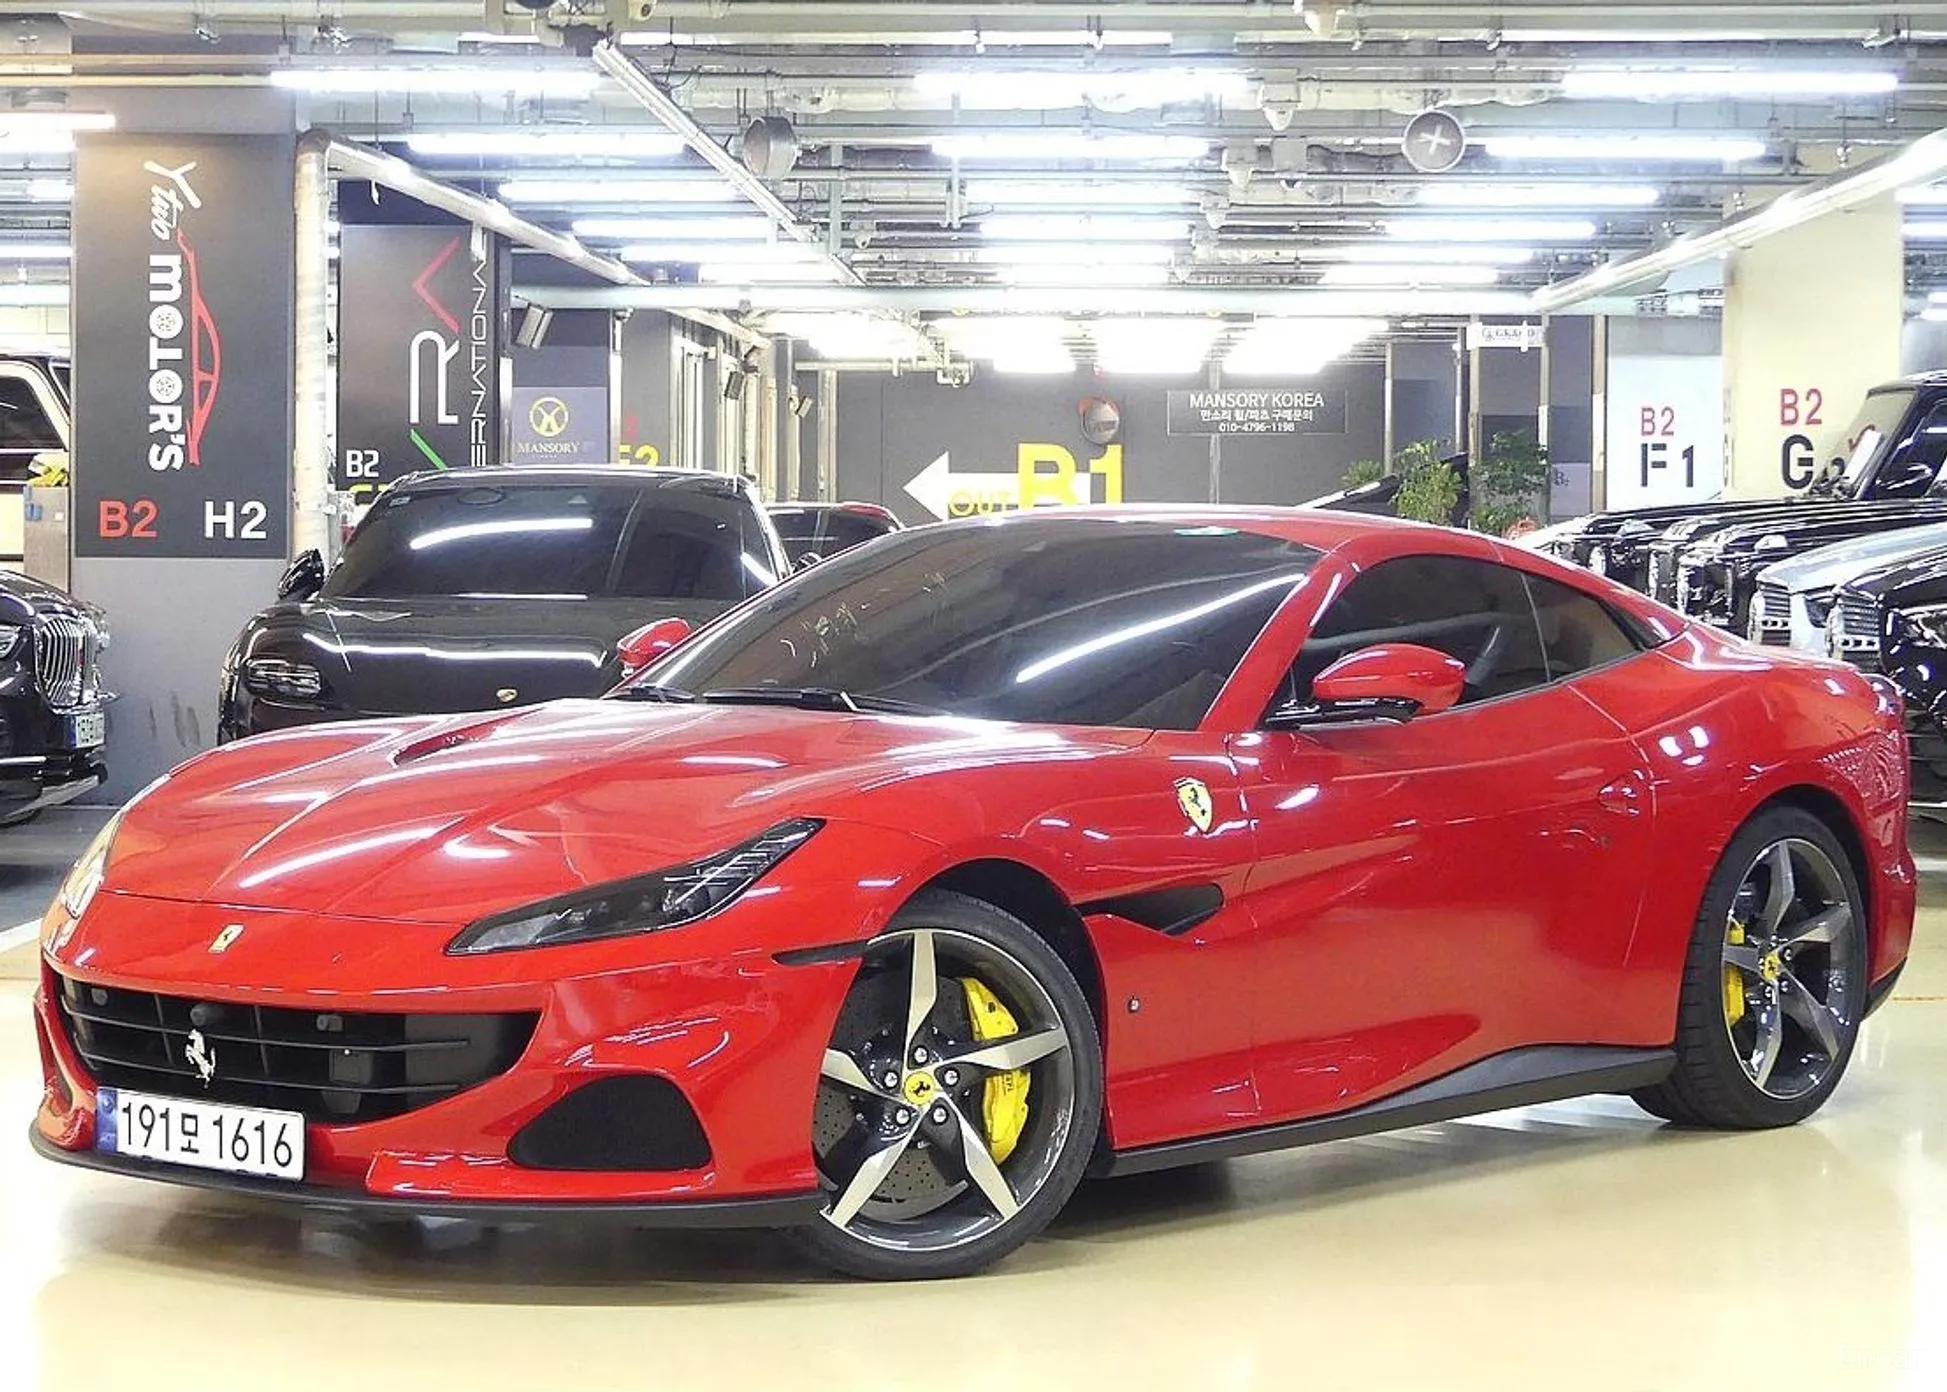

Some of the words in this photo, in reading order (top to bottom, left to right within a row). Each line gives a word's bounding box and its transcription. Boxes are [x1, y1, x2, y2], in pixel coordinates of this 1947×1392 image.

[1190, 393, 1268, 409] MANSORY
[1272, 393, 1325, 408] KOREA
[1780, 387, 1823, 426] B2
[1640, 406, 1675, 437] B2
[517, 441, 580, 454] MANSORY
[346, 449, 380, 478] B2
[99, 499, 158, 539] B2
[204, 500, 268, 540] H2
[122, 1101, 200, 1154] 191모
[212, 1114, 293, 1169] 1616
